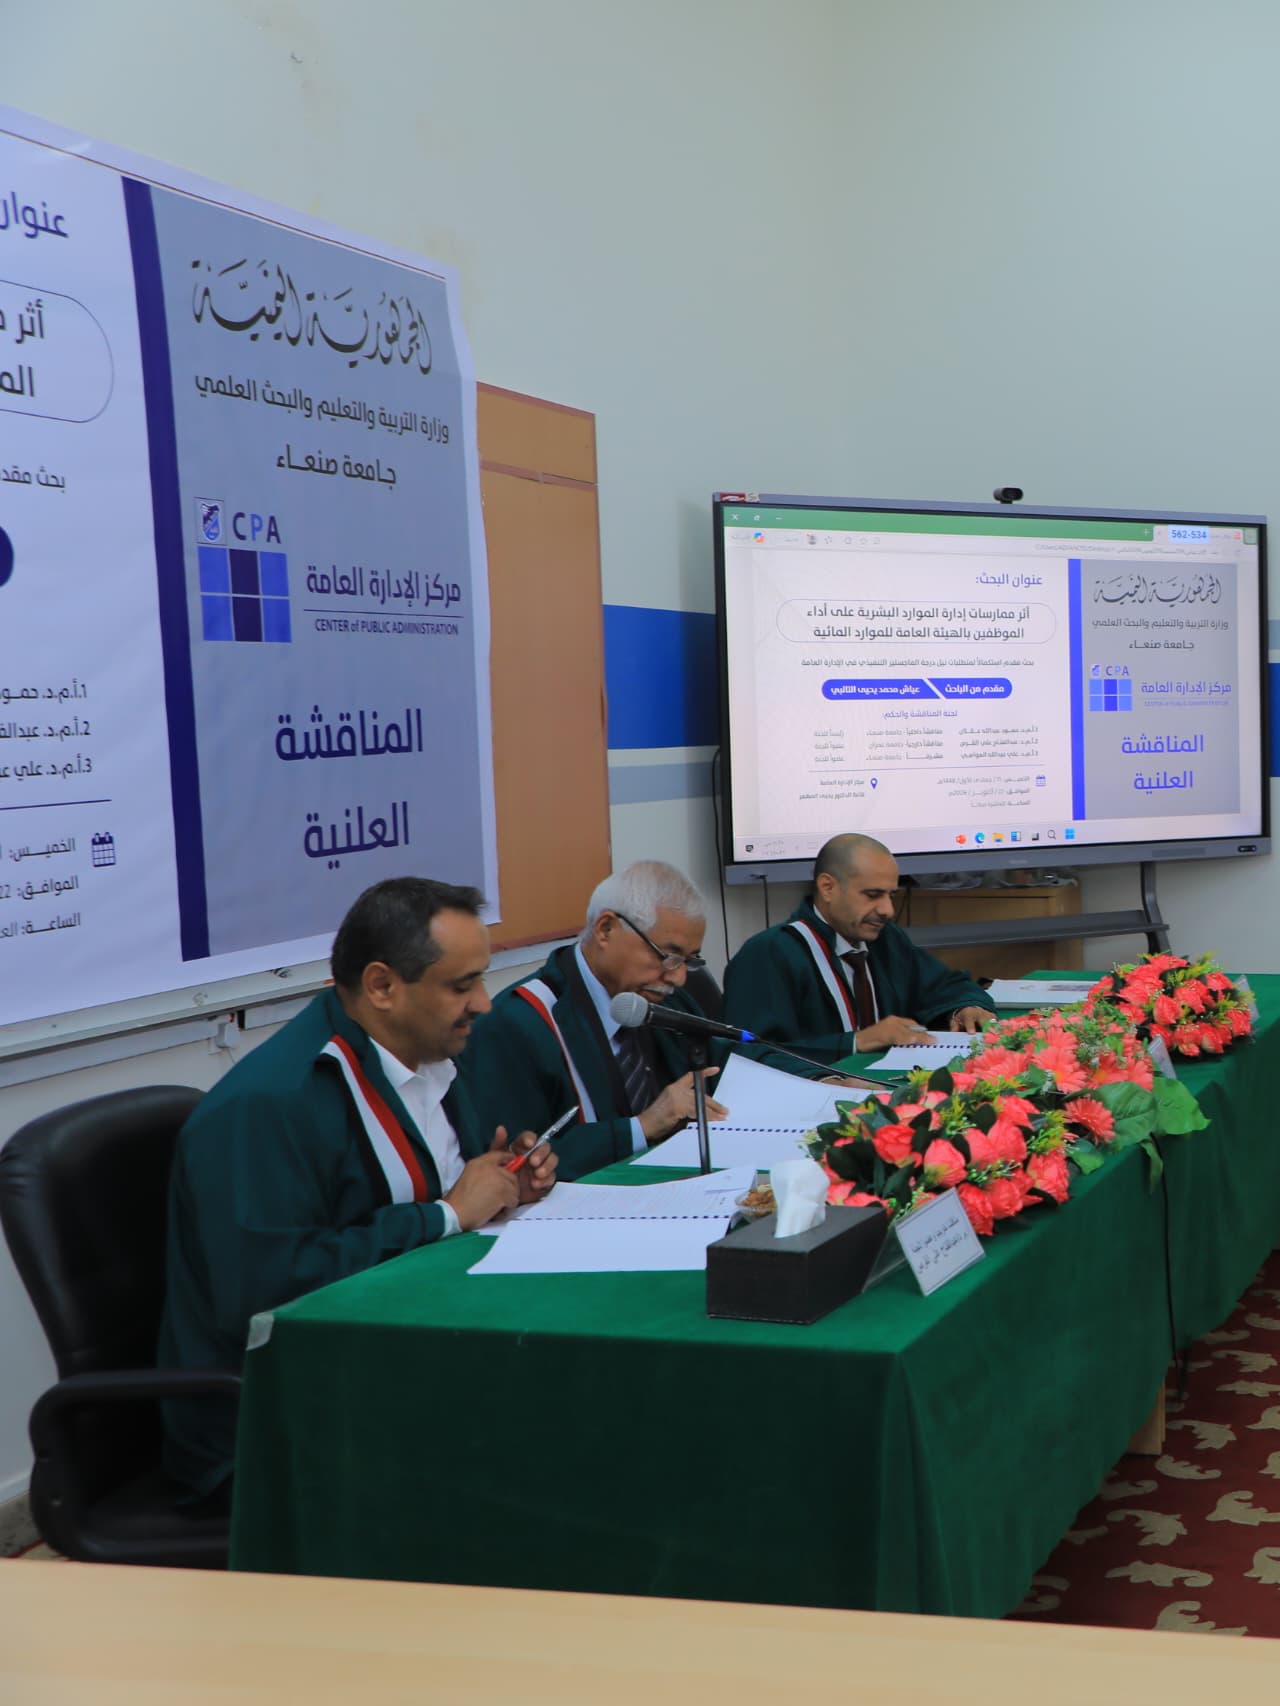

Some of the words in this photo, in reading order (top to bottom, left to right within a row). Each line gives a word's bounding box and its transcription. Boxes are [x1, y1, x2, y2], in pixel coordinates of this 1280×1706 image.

[192, 259, 301, 346] اليمنية
[15, 298, 45, 344] أثر
[306, 291, 432, 375] الجمهورية
[0, 364, 35, 397] الم
[195, 374, 257, 398] العلمي
[262, 380, 313, 418] والبحث
[317, 397, 375, 430] والتعليم
[378, 407, 418, 435] التربية
[420, 415, 449, 444] وزارة
[276, 444, 338, 475] صنعاء
[1, 464, 33, 485] مقد
[36, 465, 66, 494] بحث
[343, 454, 397, 490] جامعة
[233, 511, 282, 545] CPA
[306, 564, 364, 597] العامة
[369, 568, 420, 608] الإدارة
[424, 572, 462, 608] مركز
[1012, 573, 1043, 588] عنوان
[807, 602, 827, 617] أداء
[857, 606, 899, 620] البشرية
[902, 607, 939, 621] الموارد
[942, 608, 966, 622] إدارة
[968, 608, 1015, 622] ممارسات
[1018, 605, 1030, 622] أثر
[315, 618, 350, 633] CENTER
[351, 620, 360, 632] of
[361, 620, 390, 634] PUBLIC
[391, 622, 459, 636] ADMINISTRATION
[813, 625, 851, 639] المائية
[855, 626, 893, 640] للموارد
[896, 626, 930, 638] العامة
[973, 627, 1024, 641] الموظفين
[1129, 639, 1162, 649] صنعاء
[1163, 640, 1195, 652] جامعة
[0, 687, 39, 705] حمو
[1141, 681, 1173, 693] العامة
[1208, 681, 1232, 695] مركز
[275, 705, 423, 762] المناقشة
[1121, 733, 1204, 754] المناقشة
[14, 760, 42, 781] علي
[1134, 770, 1194, 795] العلنية
[304, 801, 410, 870] العلنية
